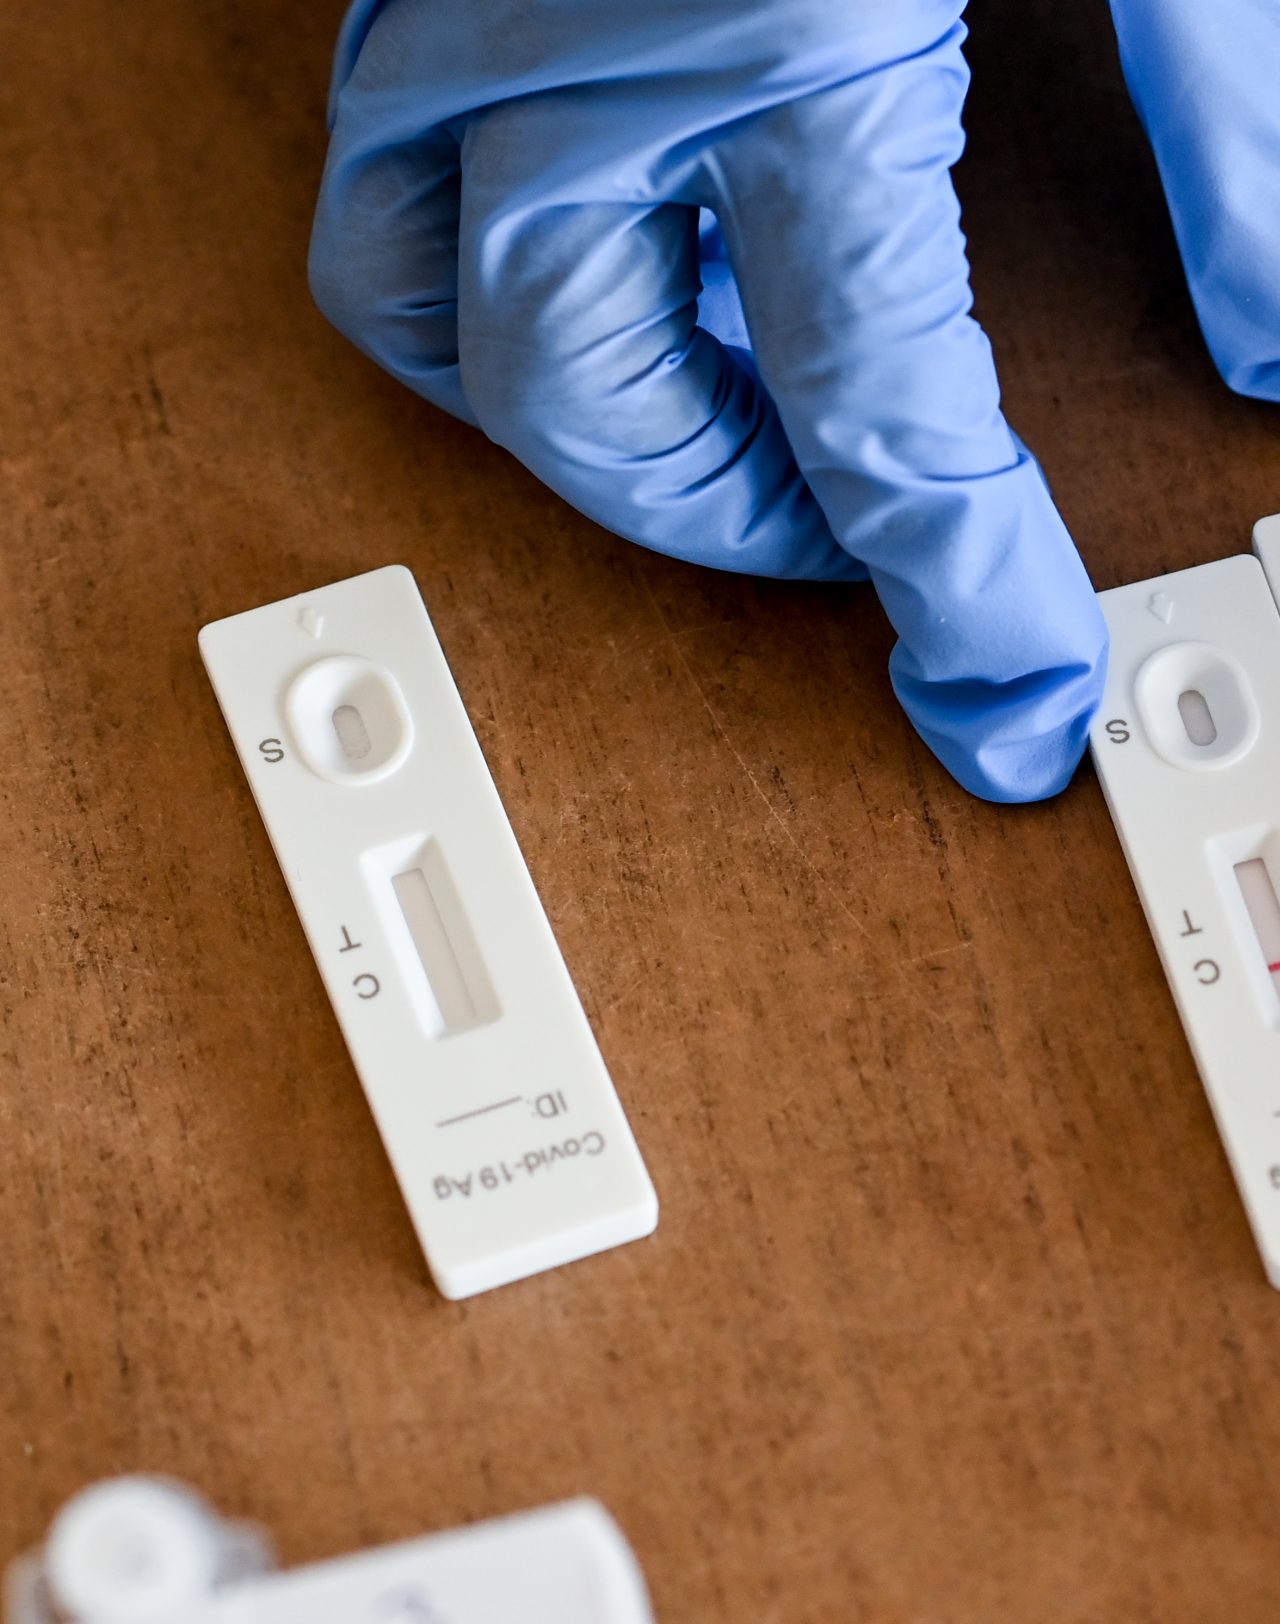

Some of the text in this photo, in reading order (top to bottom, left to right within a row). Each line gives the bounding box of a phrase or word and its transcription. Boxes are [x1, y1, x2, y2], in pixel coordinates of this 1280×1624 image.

[1105, 719, 1130, 744] S
[259, 738, 285, 763] S
[1180, 910, 1203, 937] T
[339, 925, 362, 953] T
[1193, 959, 1221, 986] C
[352, 973, 380, 1000] C
[433, 1132, 605, 1199] Covid-19 Ag
